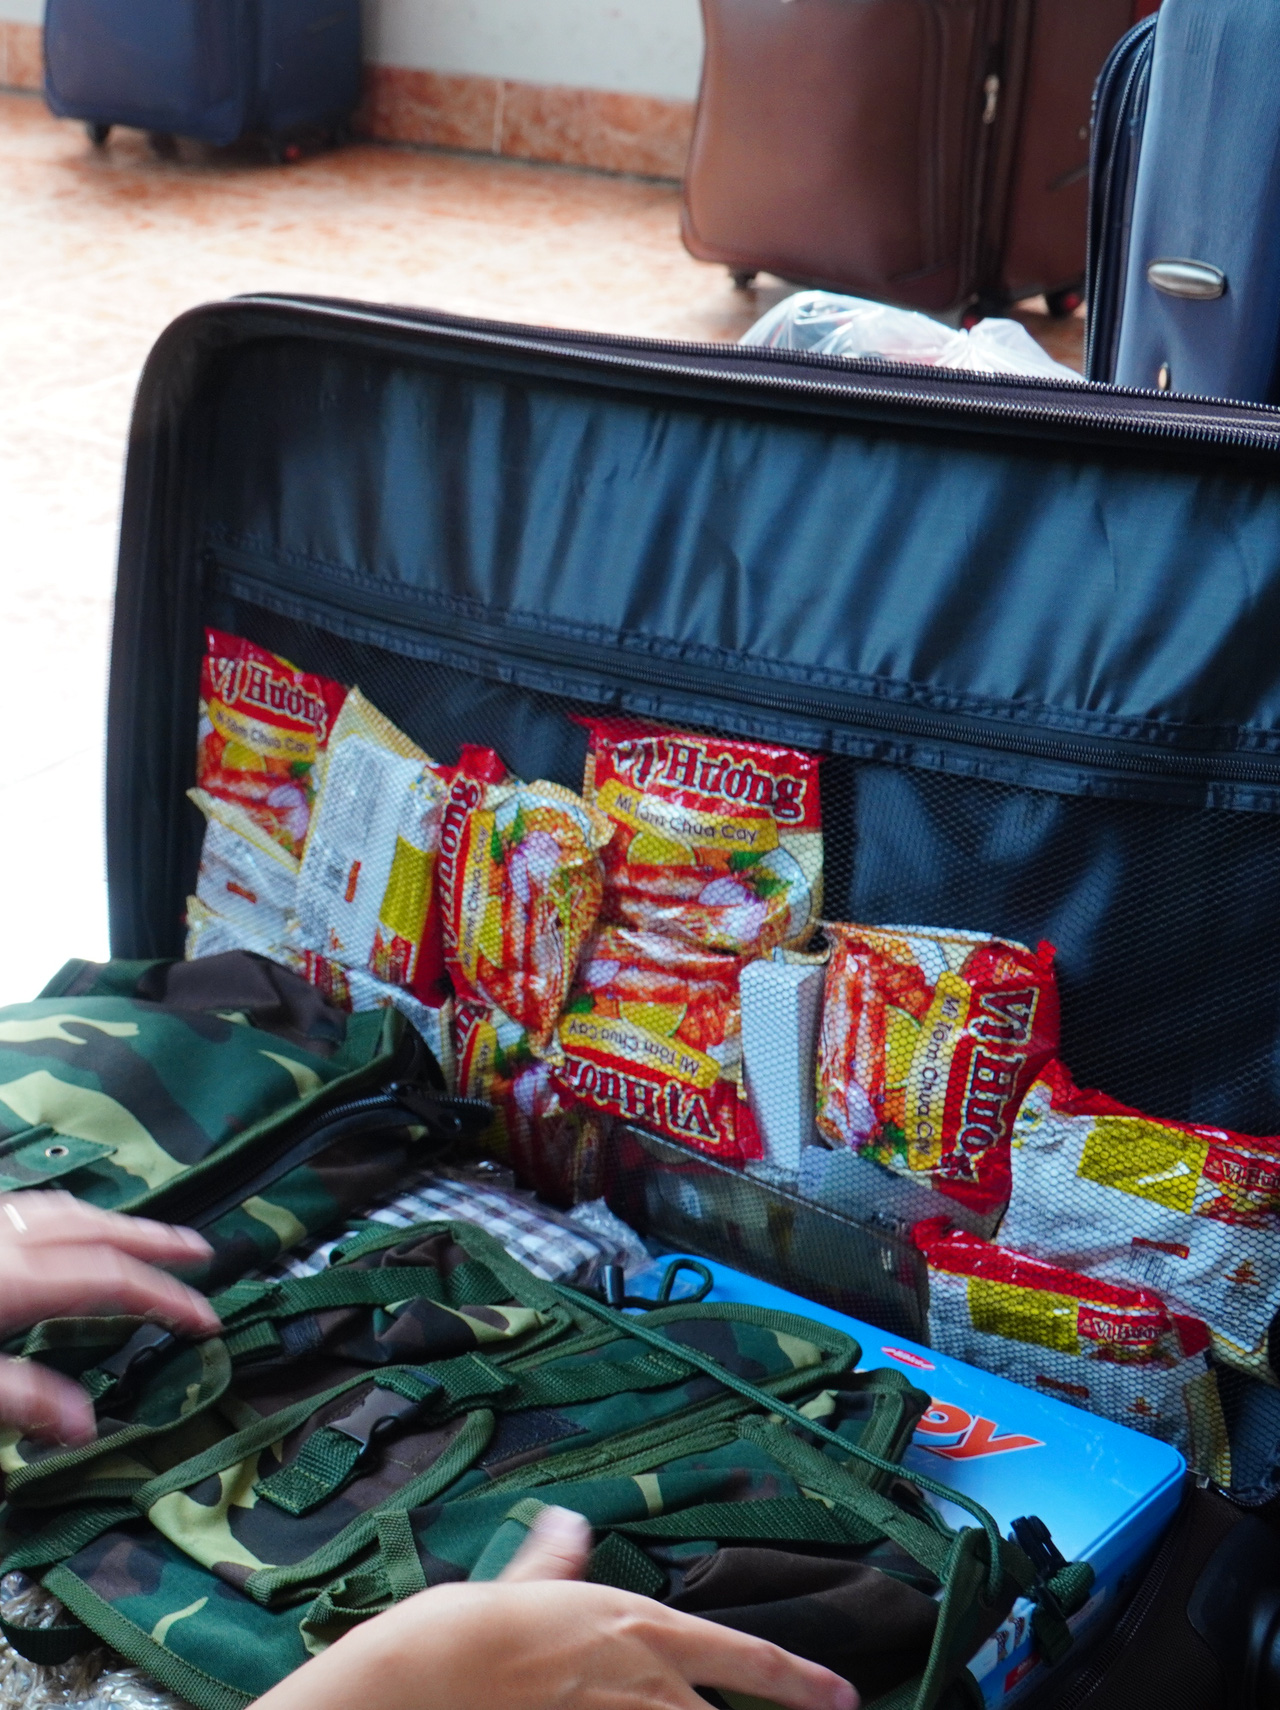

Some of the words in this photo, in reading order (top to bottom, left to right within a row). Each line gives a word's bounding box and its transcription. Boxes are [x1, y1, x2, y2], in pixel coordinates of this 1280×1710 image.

[669, 815, 716, 838] Chua
[721, 824, 758, 846] Cay
[568, 1019, 599, 1041] Cay
[600, 1028, 640, 1051] Chua
[919, 1067, 938, 1114] Chua
